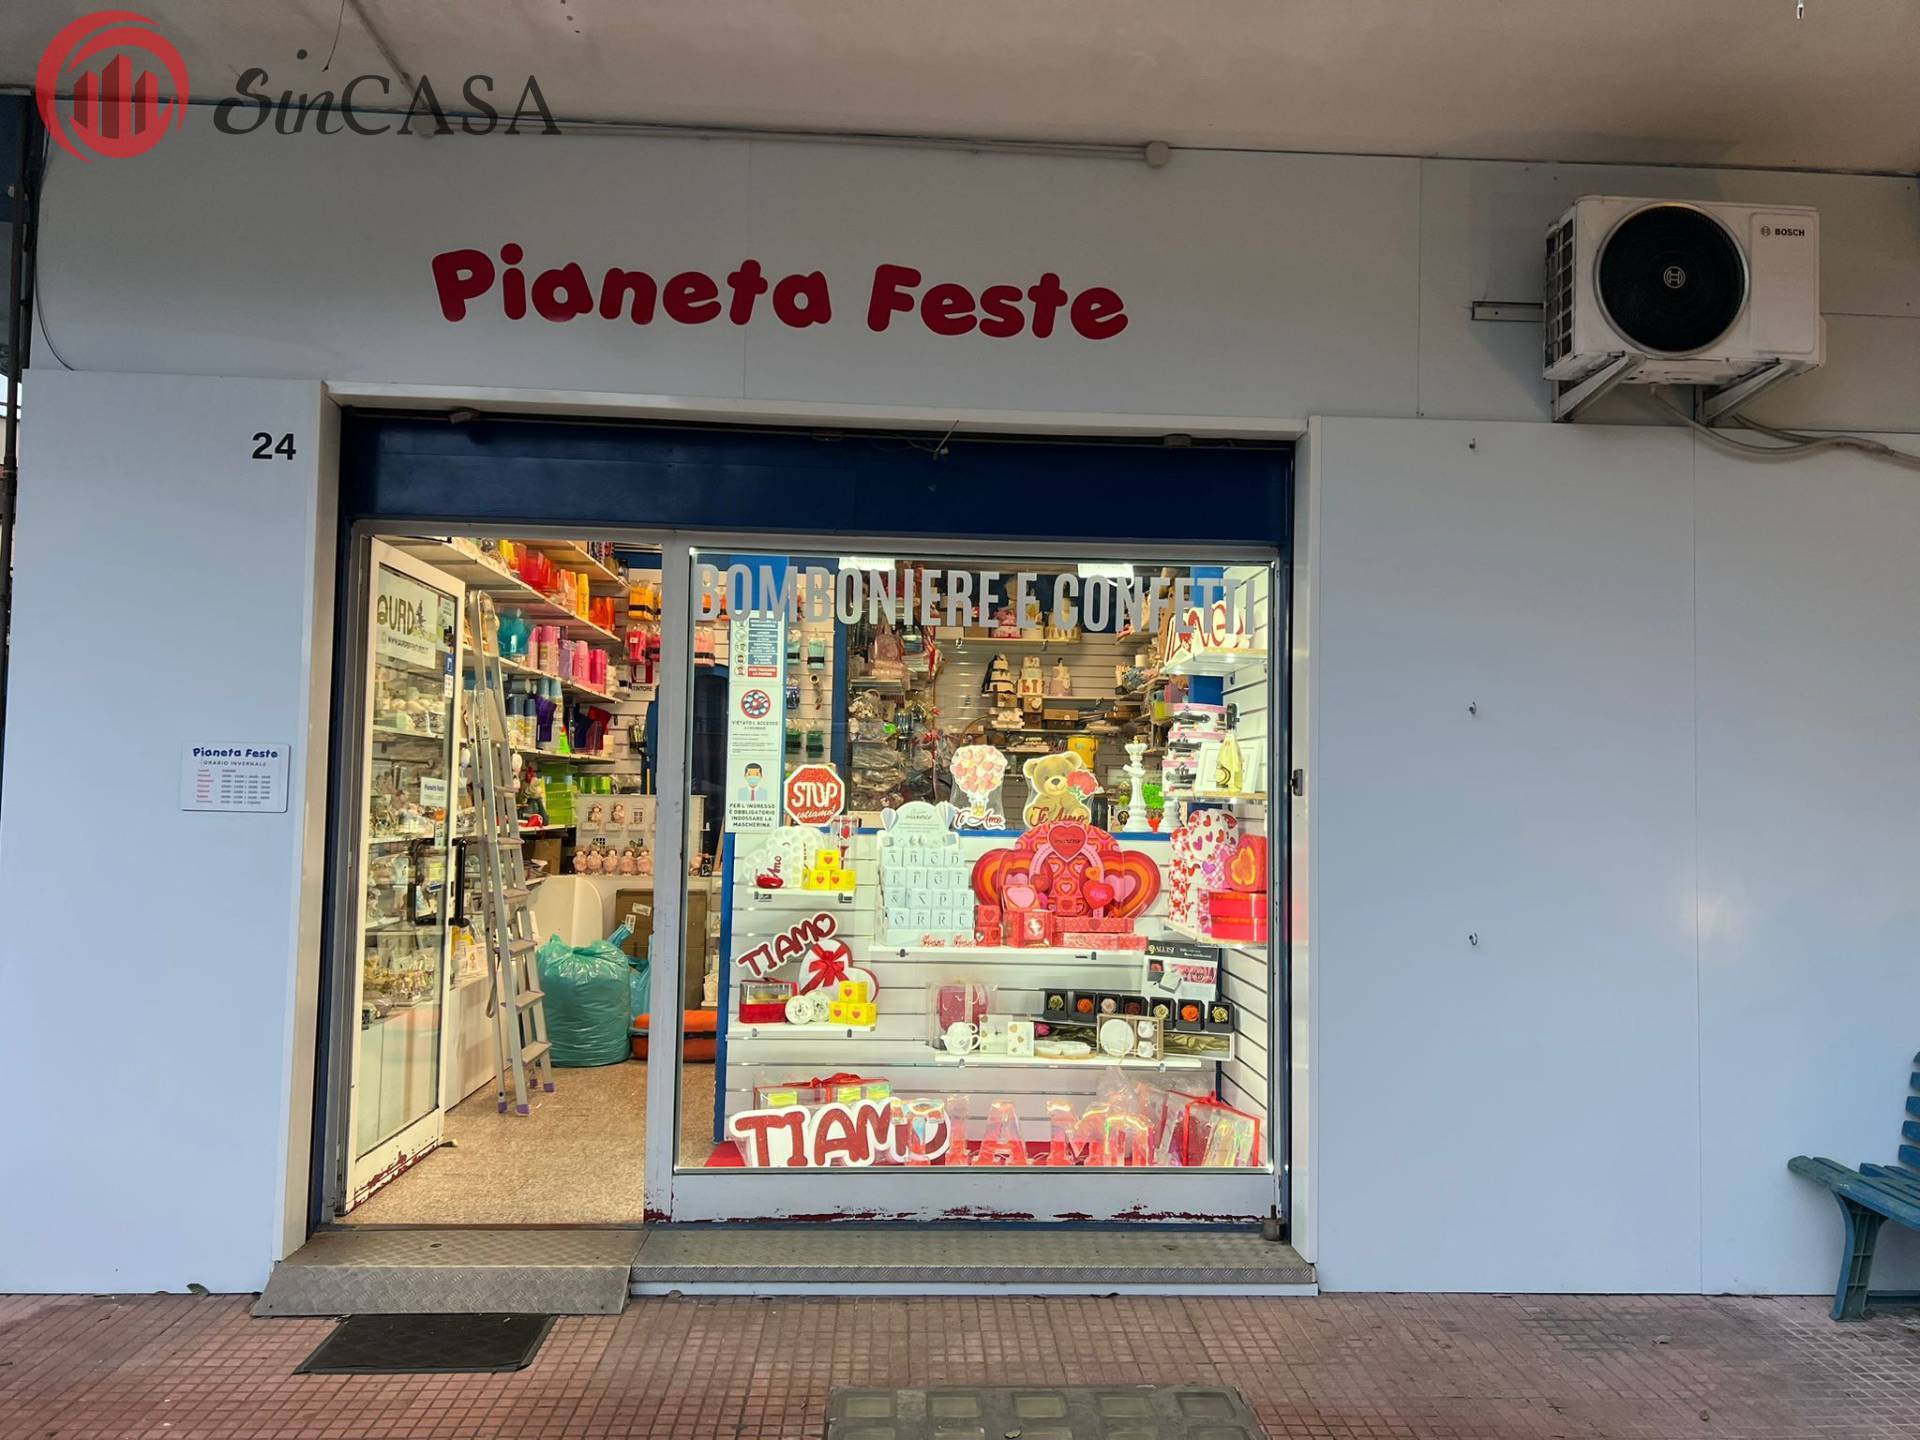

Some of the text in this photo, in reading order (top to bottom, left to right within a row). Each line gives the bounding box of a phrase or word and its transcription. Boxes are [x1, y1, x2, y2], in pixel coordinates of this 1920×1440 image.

[1774, 228, 1805, 237] BOSCH
[431, 243, 1128, 340] Pianeta Feste
[252, 432, 297, 460] 24
[694, 563, 1255, 635] BOMBONIERE E CONFETTI
[192, 747, 278, 758] Pianeta Feste
[791, 781, 838, 808] STOP
[954, 808, 970, 828] Ti
[974, 809, 1004, 828] Amo
